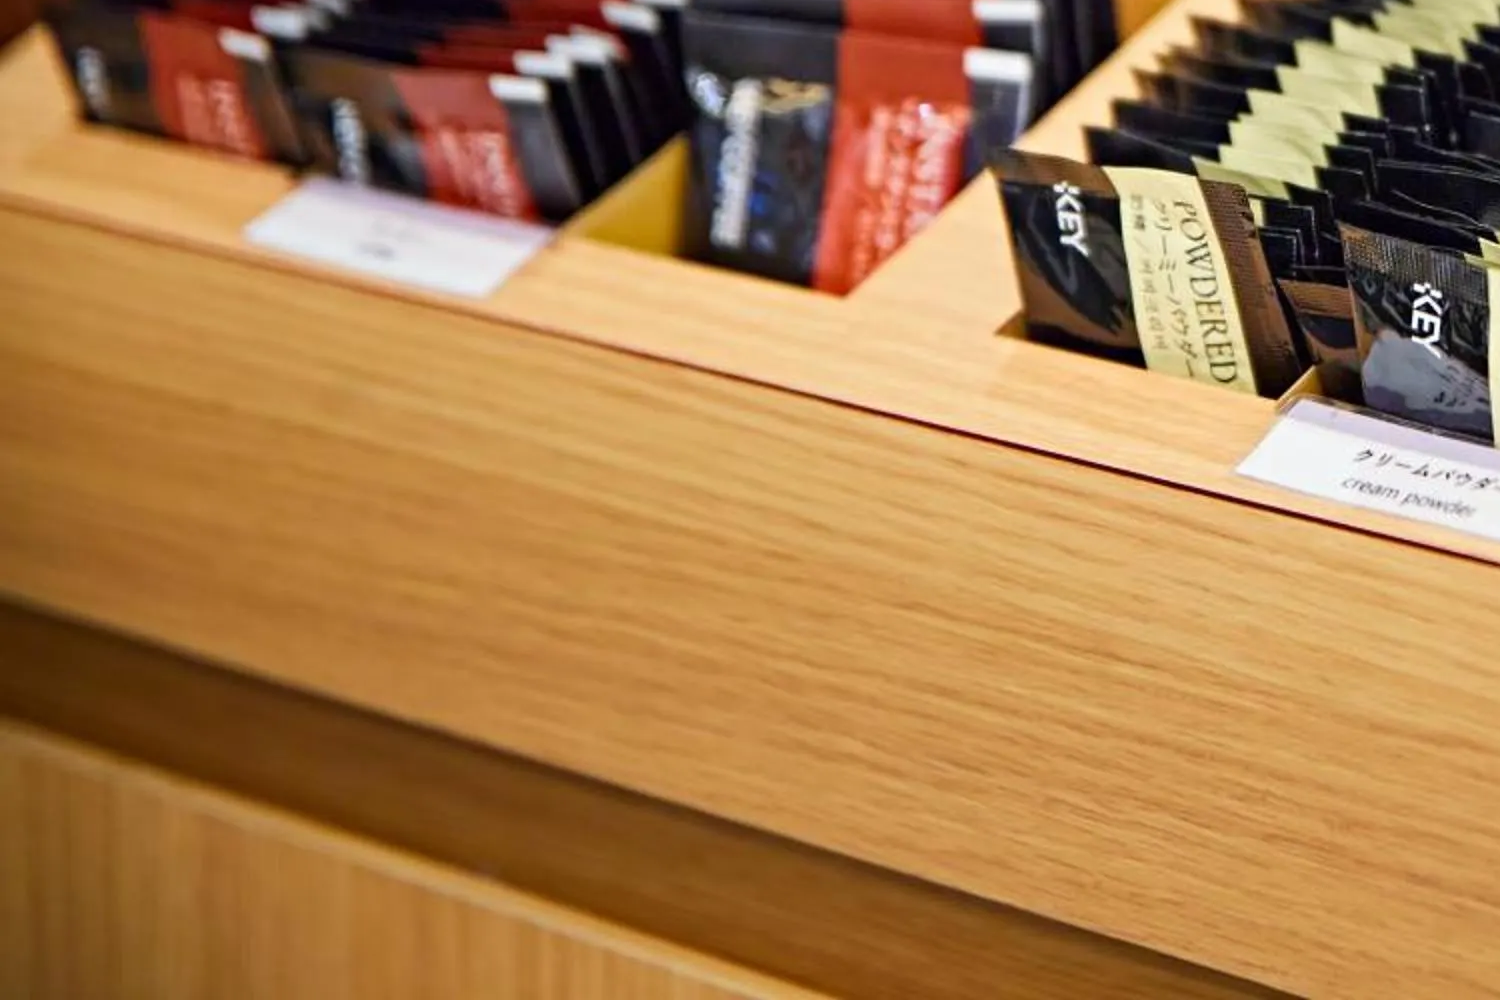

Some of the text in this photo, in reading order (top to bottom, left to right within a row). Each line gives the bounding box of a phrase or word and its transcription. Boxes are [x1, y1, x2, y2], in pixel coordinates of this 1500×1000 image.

[1054, 184, 1089, 257] KEY
[1172, 198, 1238, 385] POWDERED
[1411, 283, 1447, 358] KEY
[1340, 477, 1478, 519] cream powder
